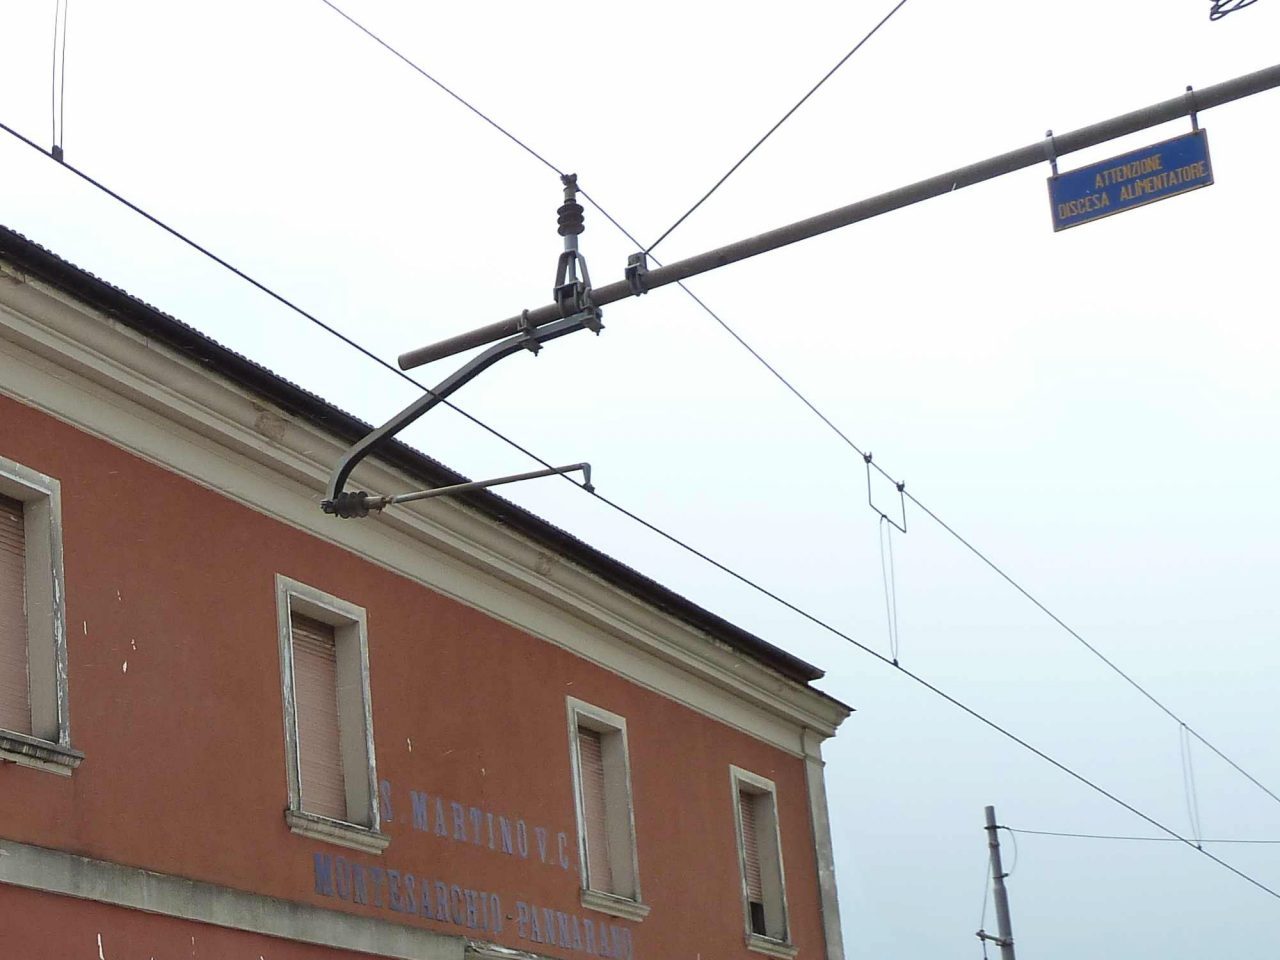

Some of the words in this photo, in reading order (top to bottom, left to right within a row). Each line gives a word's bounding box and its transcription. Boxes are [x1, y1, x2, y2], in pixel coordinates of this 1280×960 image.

[1058, 192, 1110, 219] DISCESA
[1120, 160, 1208, 201] ALIMENTATORE
[1095, 154, 1163, 189] ATTENZIONE
[410, 789, 528, 859] MARTINO
[313, 852, 503, 935] MONTESARCHIO
